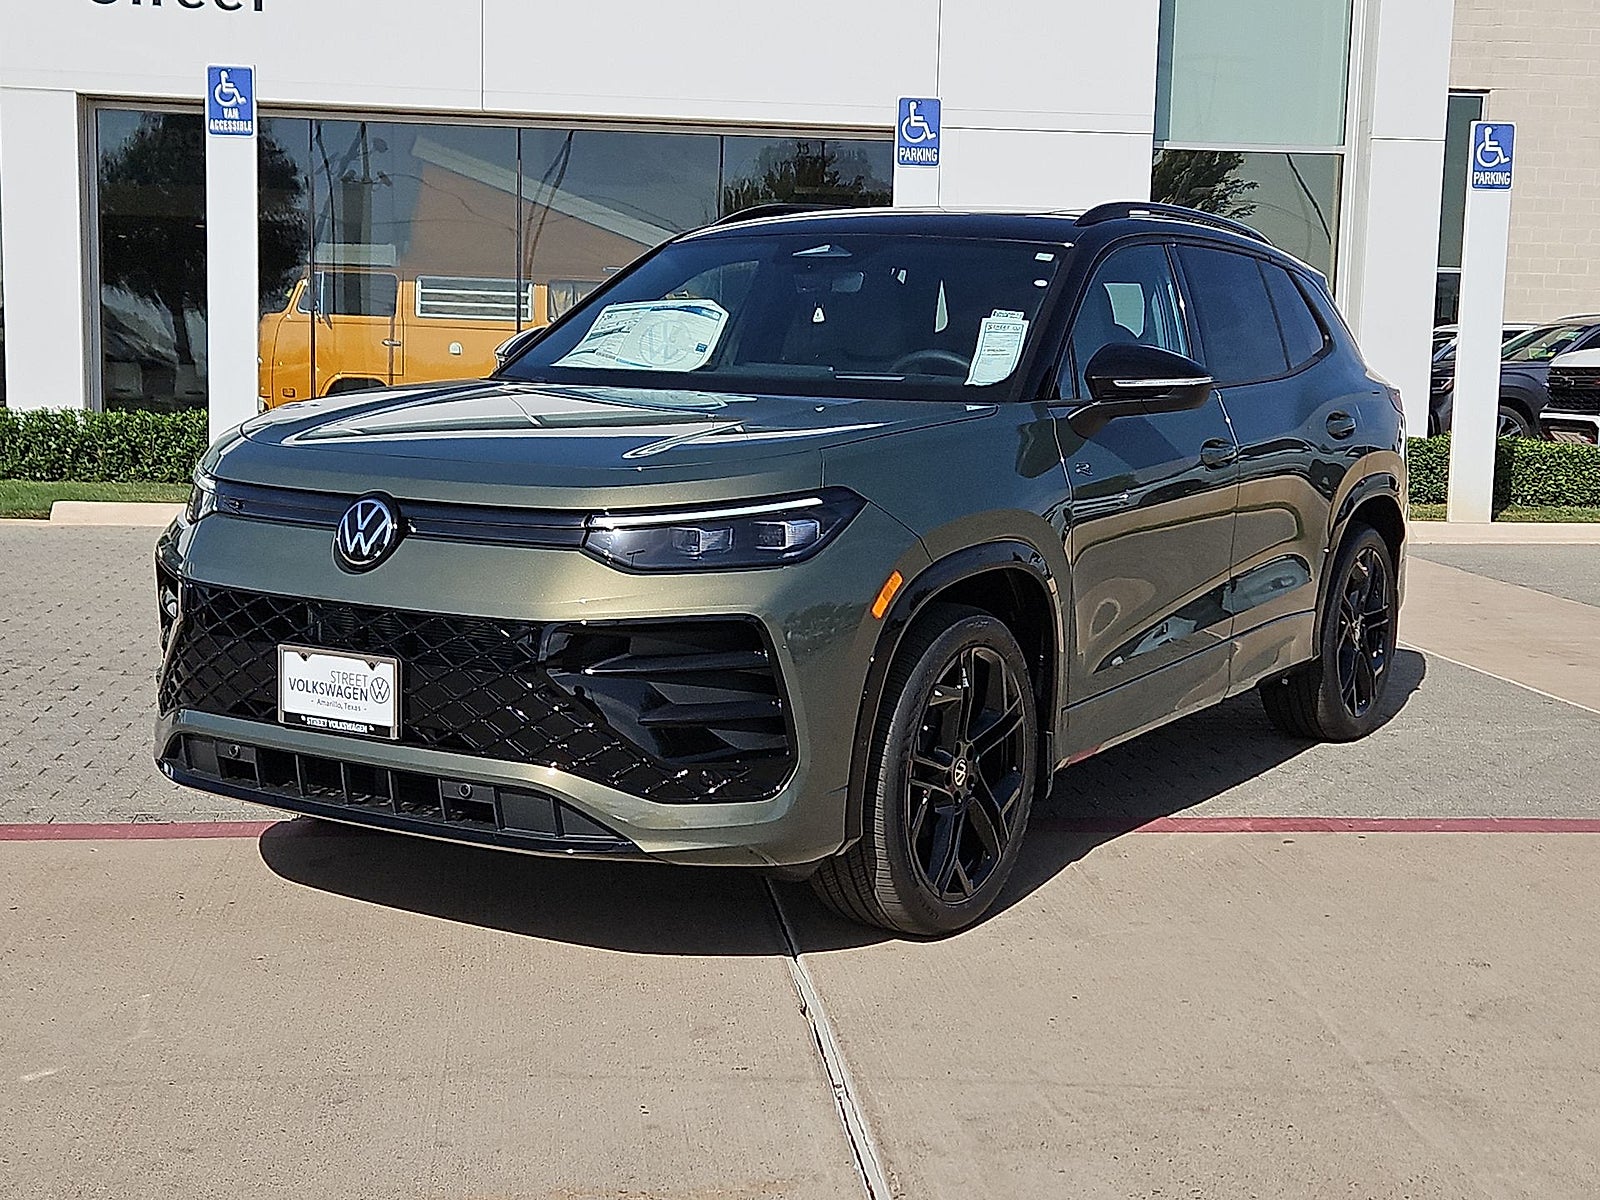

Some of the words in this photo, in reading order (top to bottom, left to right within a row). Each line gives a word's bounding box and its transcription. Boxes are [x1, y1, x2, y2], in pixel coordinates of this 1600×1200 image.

[223, 107, 239, 119] VAN
[209, 118, 252, 132] ACCESSIBLE
[899, 146, 938, 162] PARKING
[1473, 171, 1511, 185] PARKING
[330, 670, 368, 688] STREET
[288, 676, 368, 702] VOLKSWAGEN
[344, 702, 362, 712] Texas
[306, 717, 327, 727] STREET
[328, 720, 368, 733] VOLKSWAGEN
